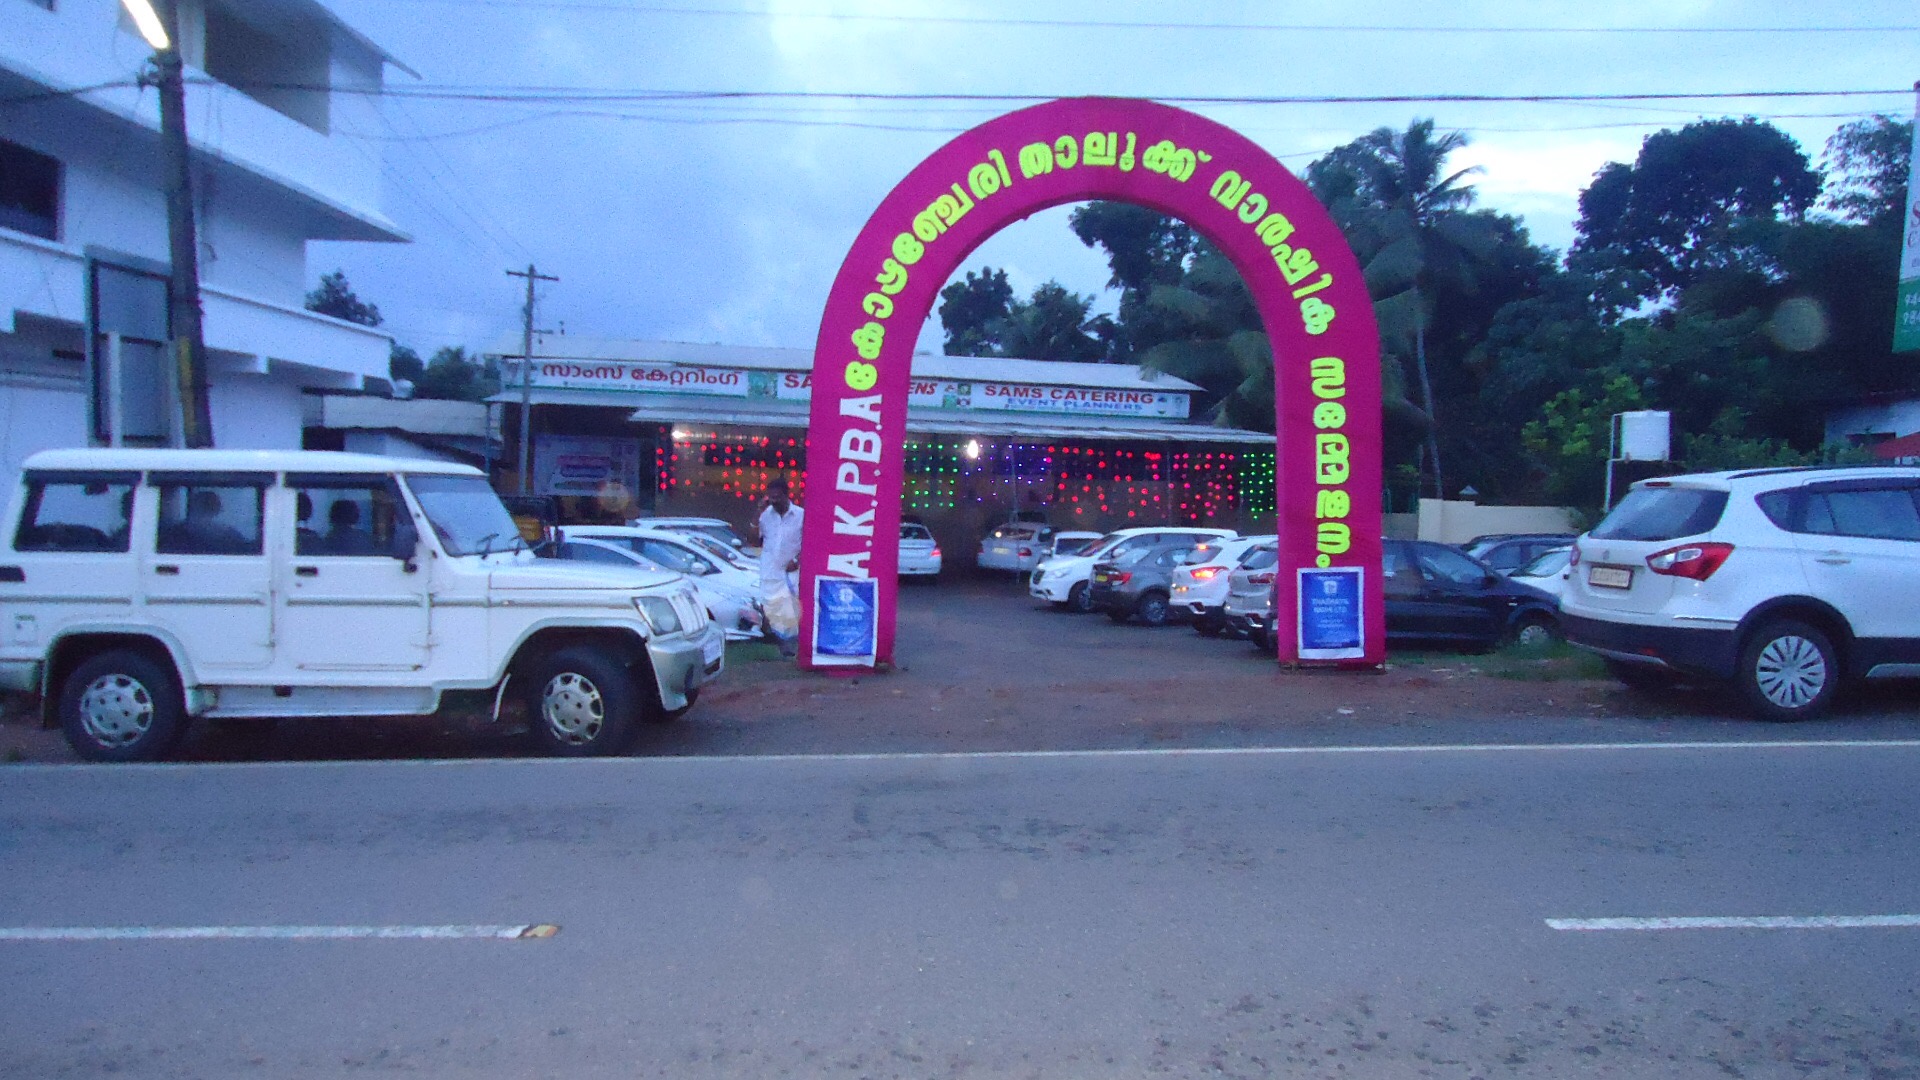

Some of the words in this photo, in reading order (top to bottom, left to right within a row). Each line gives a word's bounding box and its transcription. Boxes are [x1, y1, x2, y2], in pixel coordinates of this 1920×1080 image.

[543, 364, 625, 379] സാംസ്
[631, 367, 742, 386] കേറ്ററിംഗ്
[985, 385, 1042, 398] SAMS
[1051, 388, 1154, 404] CATERING
[1007, 397, 1057, 407] EVENT
[1064, 400, 1142, 410] PLANNERS
[828, 395, 883, 581] A.K.P.B.A
